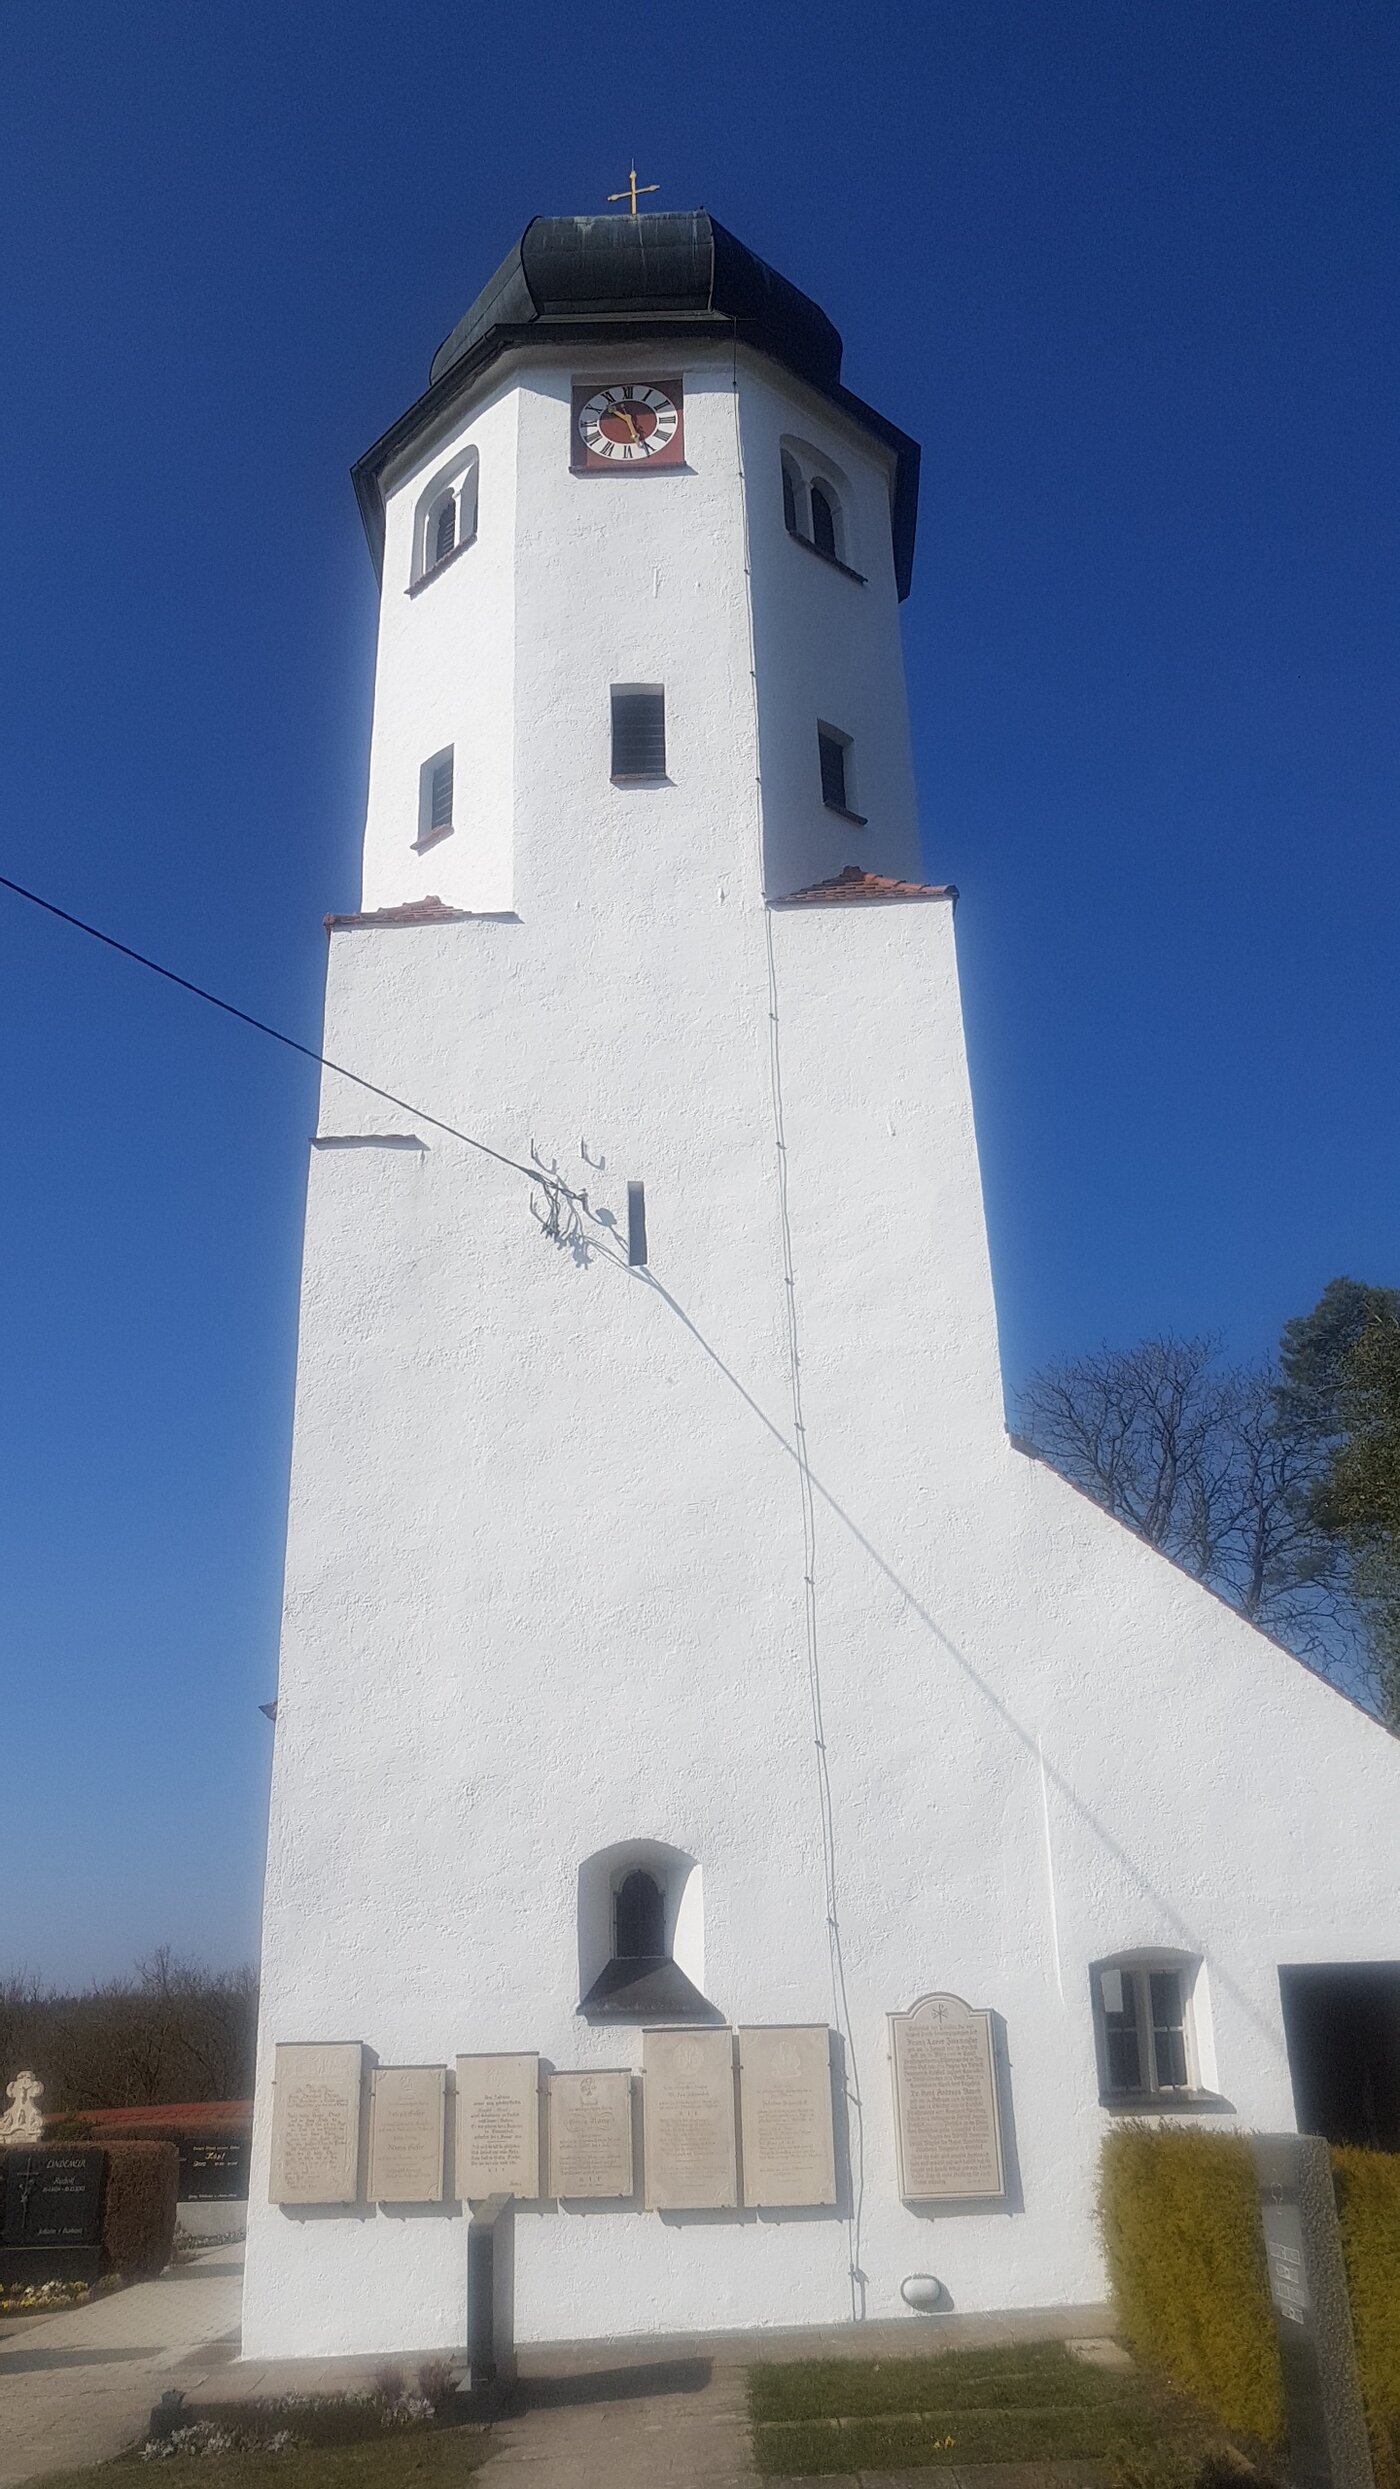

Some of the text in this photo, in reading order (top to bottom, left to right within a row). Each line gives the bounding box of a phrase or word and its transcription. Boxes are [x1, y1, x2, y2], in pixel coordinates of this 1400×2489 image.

[601, 391, 616, 404] XI
[622, 386, 634, 400] XII
[585, 404, 602, 414] X
[653, 400, 670, 411] II
[659, 415, 676, 424] III
[600, 441, 615, 457] VII
[623, 445, 633, 459] VI
